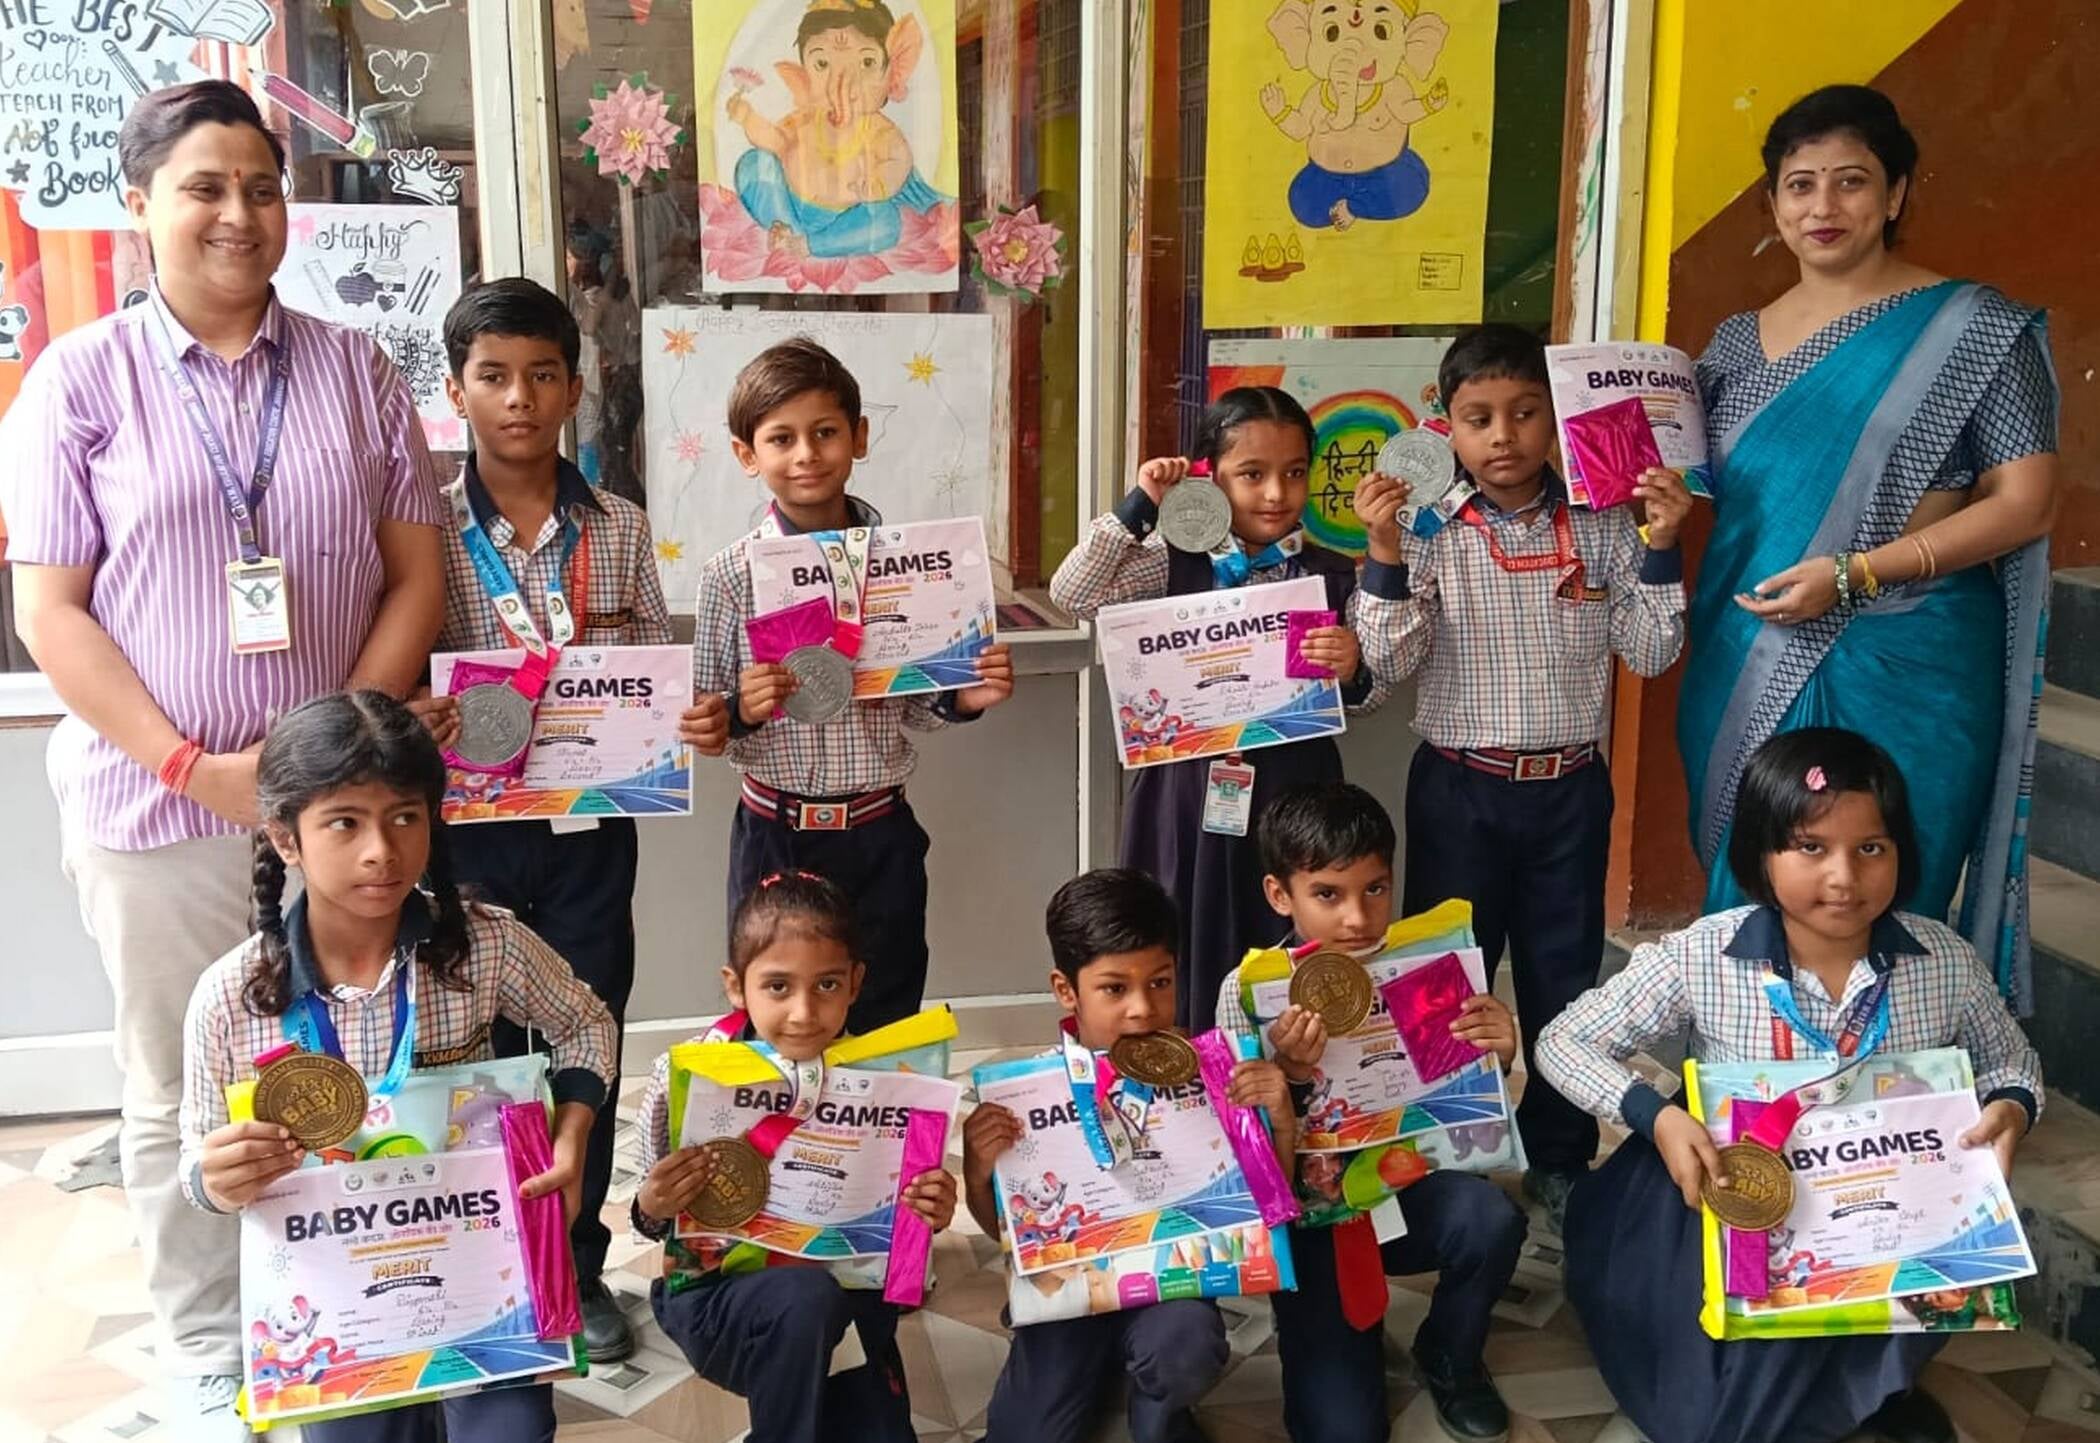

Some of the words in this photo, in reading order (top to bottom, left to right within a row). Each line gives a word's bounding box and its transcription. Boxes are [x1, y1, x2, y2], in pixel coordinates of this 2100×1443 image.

[0, 93, 62, 115] TEACH
[71, 94, 124, 121] FROM
[69, 121, 119, 160] fro
[315, 219, 414, 260] Happy
[1587, 369, 1643, 389] BABY
[1647, 370, 1695, 396] GAMES
[792, 565, 833, 588] BA
[868, 551, 953, 578] GAMES
[924, 571, 953, 583] 2026
[1138, 628, 1201, 655] BABY
[1205, 611, 1290, 643] GAMES
[1263, 631, 1289, 644] 202
[555, 677, 654, 699] GAMES
[619, 698, 652, 709] 2026
[280, 1087, 338, 1125] BABY
[733, 1088, 793, 1113] BAB
[815, 1101, 909, 1128] GAMES
[1173, 1096, 1208, 1112] 2026
[874, 1129, 905, 1139] 2026
[1836, 1128, 1943, 1162] GAMES
[1911, 1152, 1946, 1165] 2026
[285, 1203, 379, 1242] BABY
[385, 1189, 501, 1227] GAMES
[463, 1217, 501, 1232] 2026
[371, 1257, 432, 1280] MERIT
